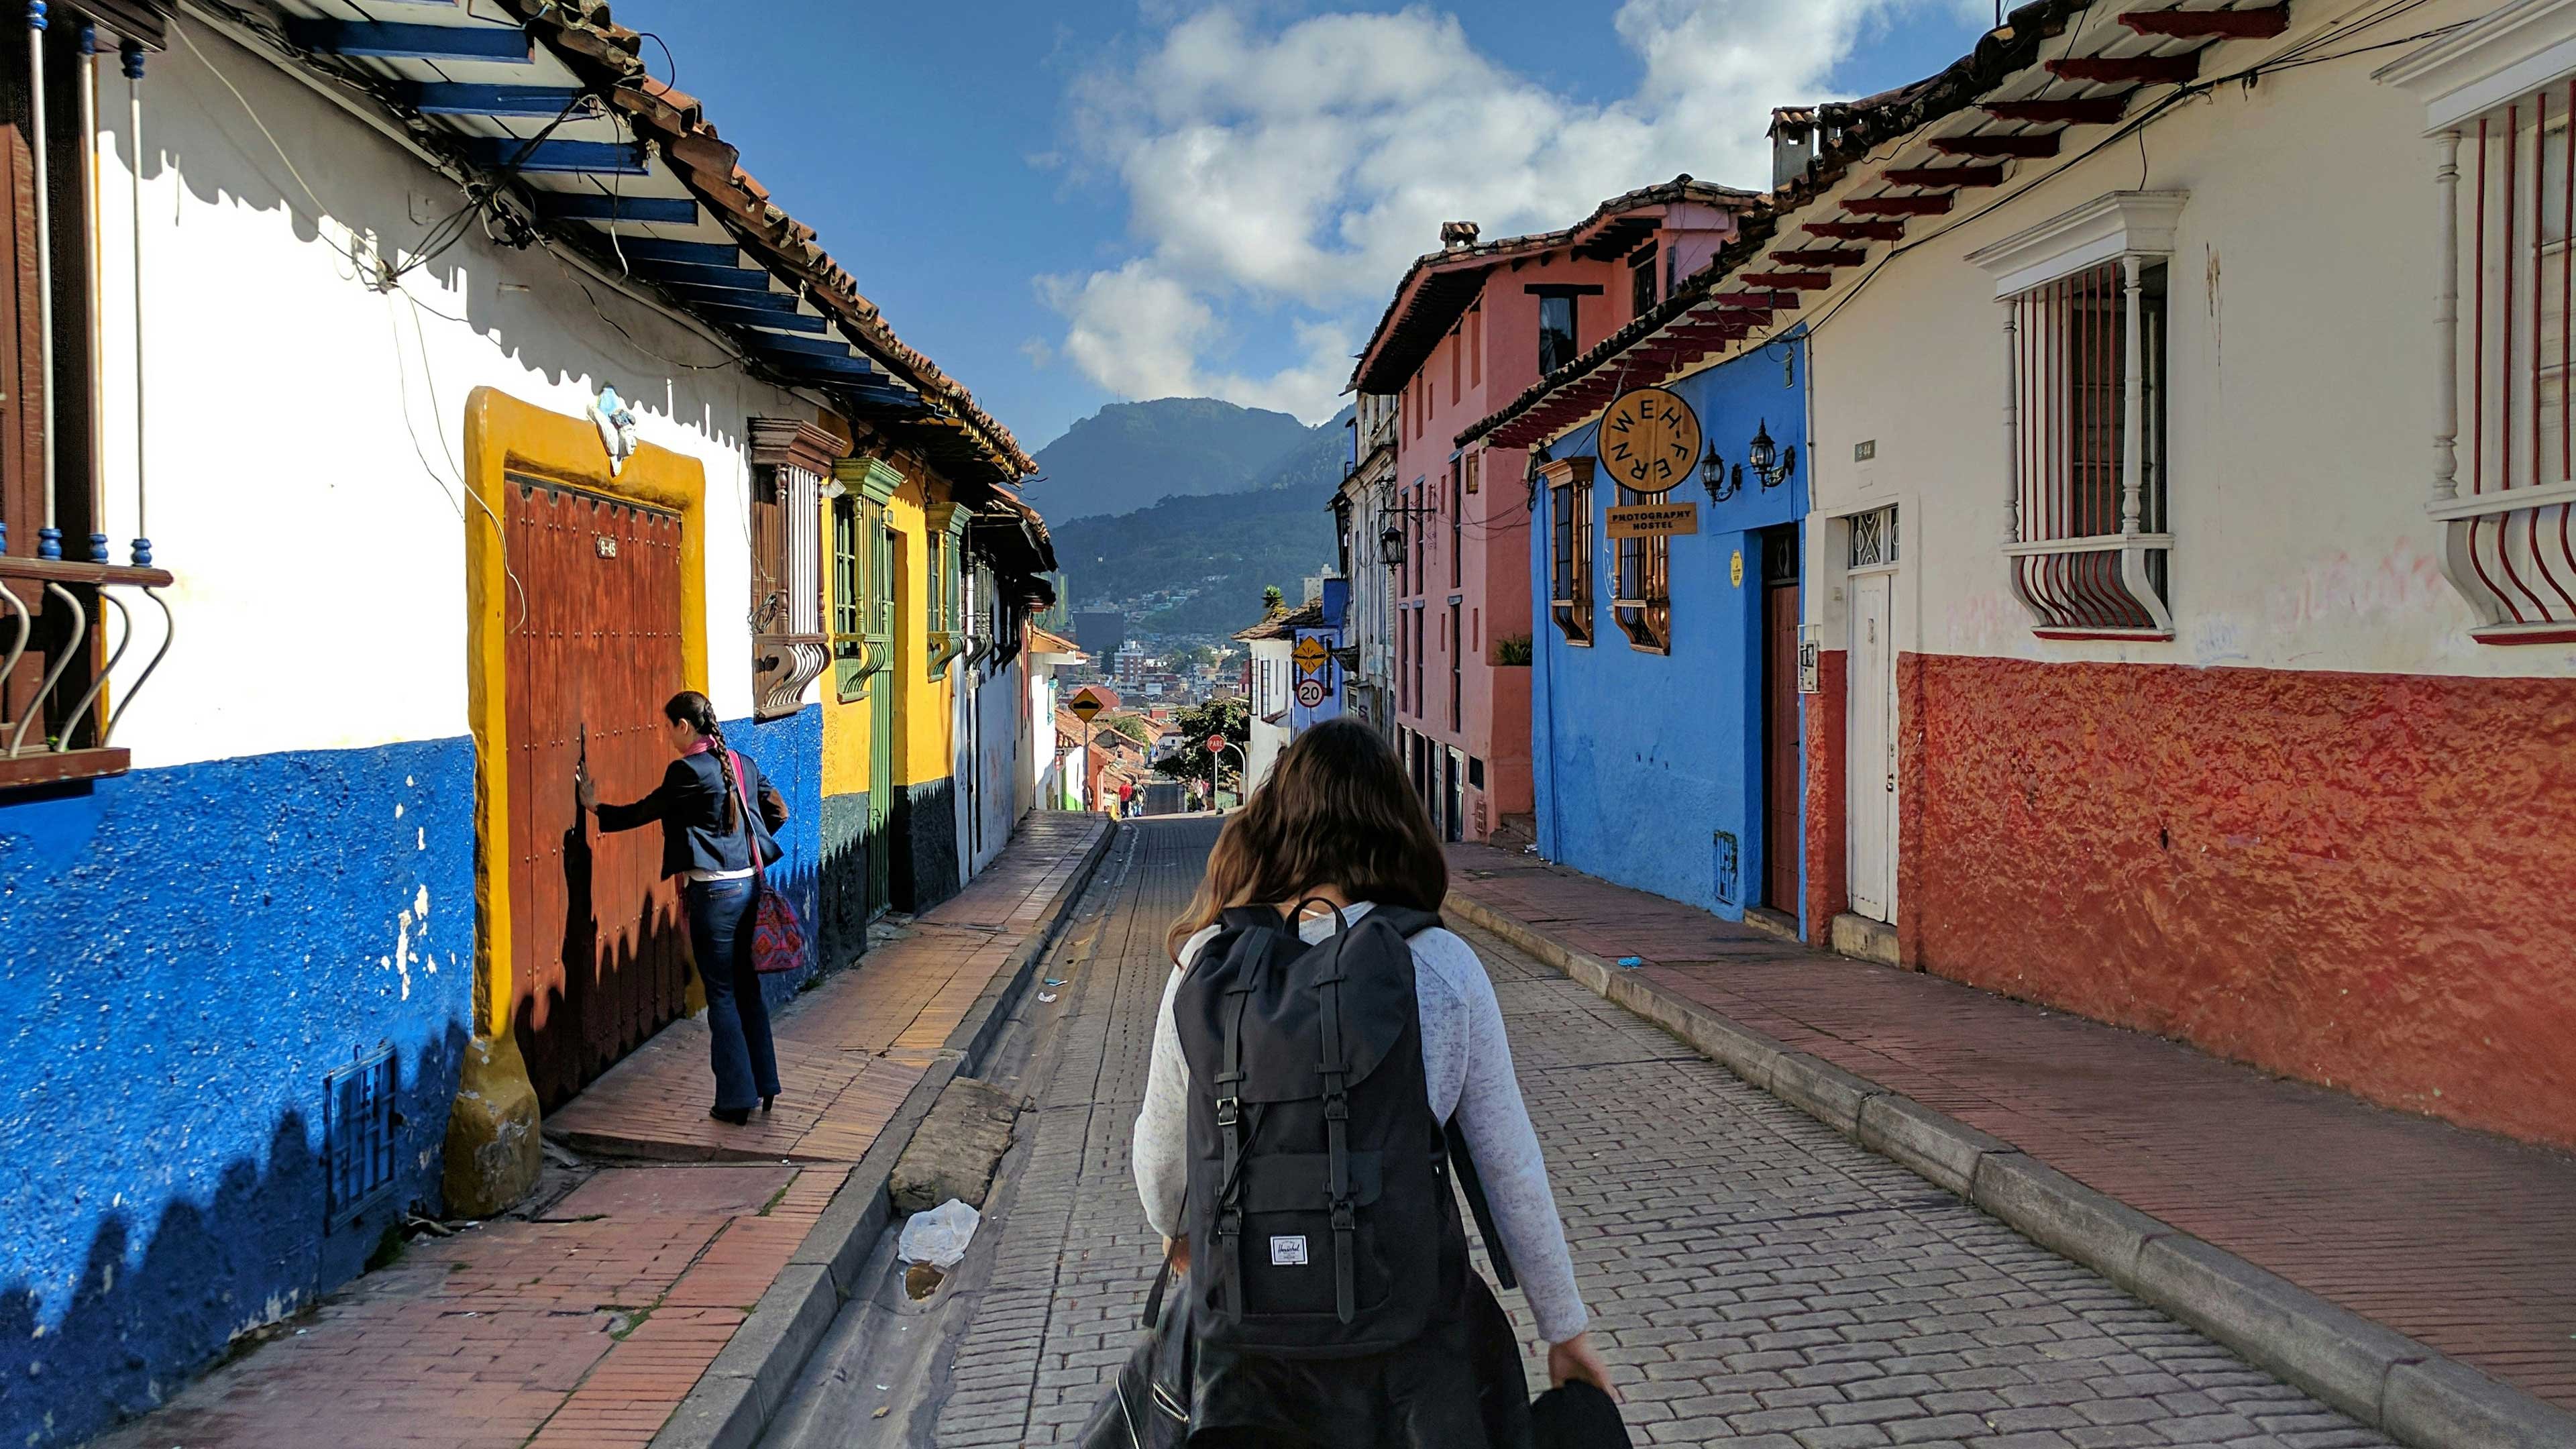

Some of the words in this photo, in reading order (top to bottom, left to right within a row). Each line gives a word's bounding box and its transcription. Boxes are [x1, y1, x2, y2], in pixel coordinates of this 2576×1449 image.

[1612, 511, 1690, 521] PHOTOGRAPHY
[1633, 521, 1673, 530] HOSTEL
[600, 540, 616, 557] 9-45
[1301, 686, 1320, 700] 20
[1278, 1243, 1300, 1254] Herschel
